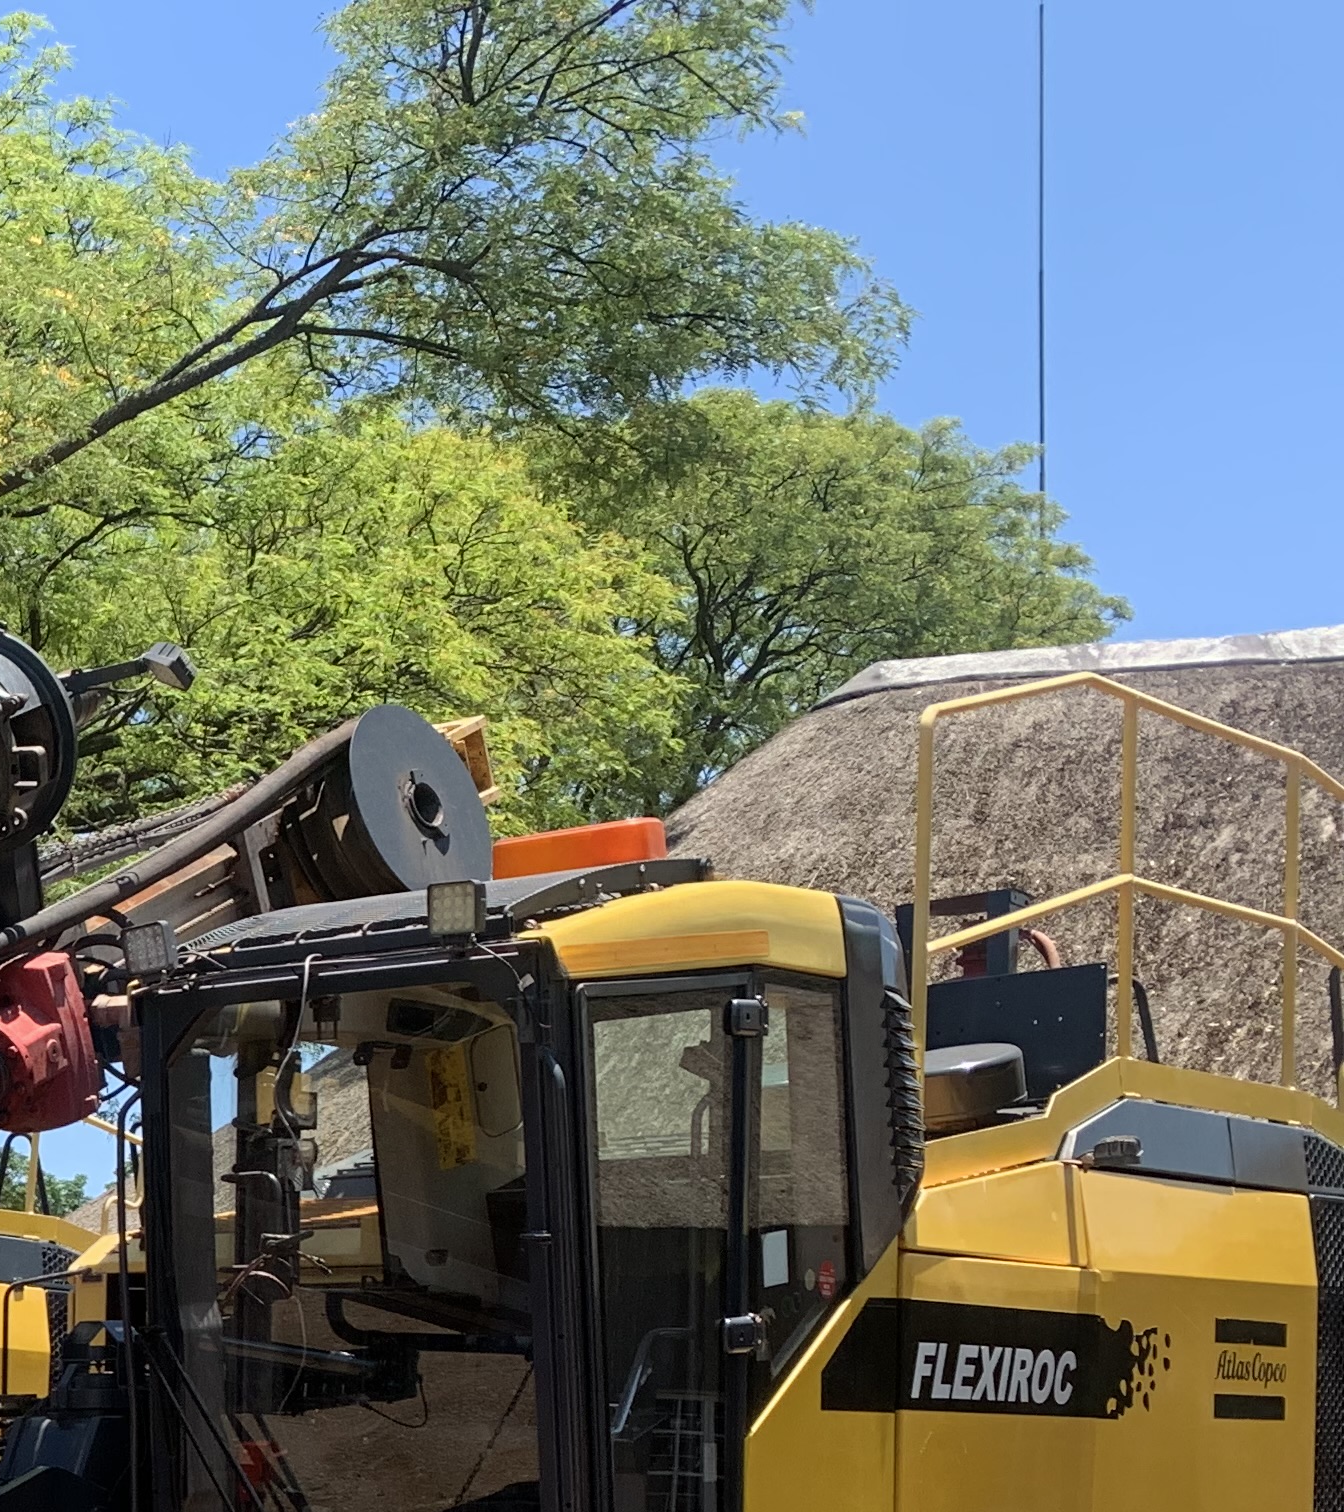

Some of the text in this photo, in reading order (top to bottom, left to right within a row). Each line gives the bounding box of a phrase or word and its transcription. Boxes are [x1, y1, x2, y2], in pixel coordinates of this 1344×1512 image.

[911, 1342, 1077, 1405] FLEXIROC
[1215, 1350, 1286, 1389] Atlas Copco
